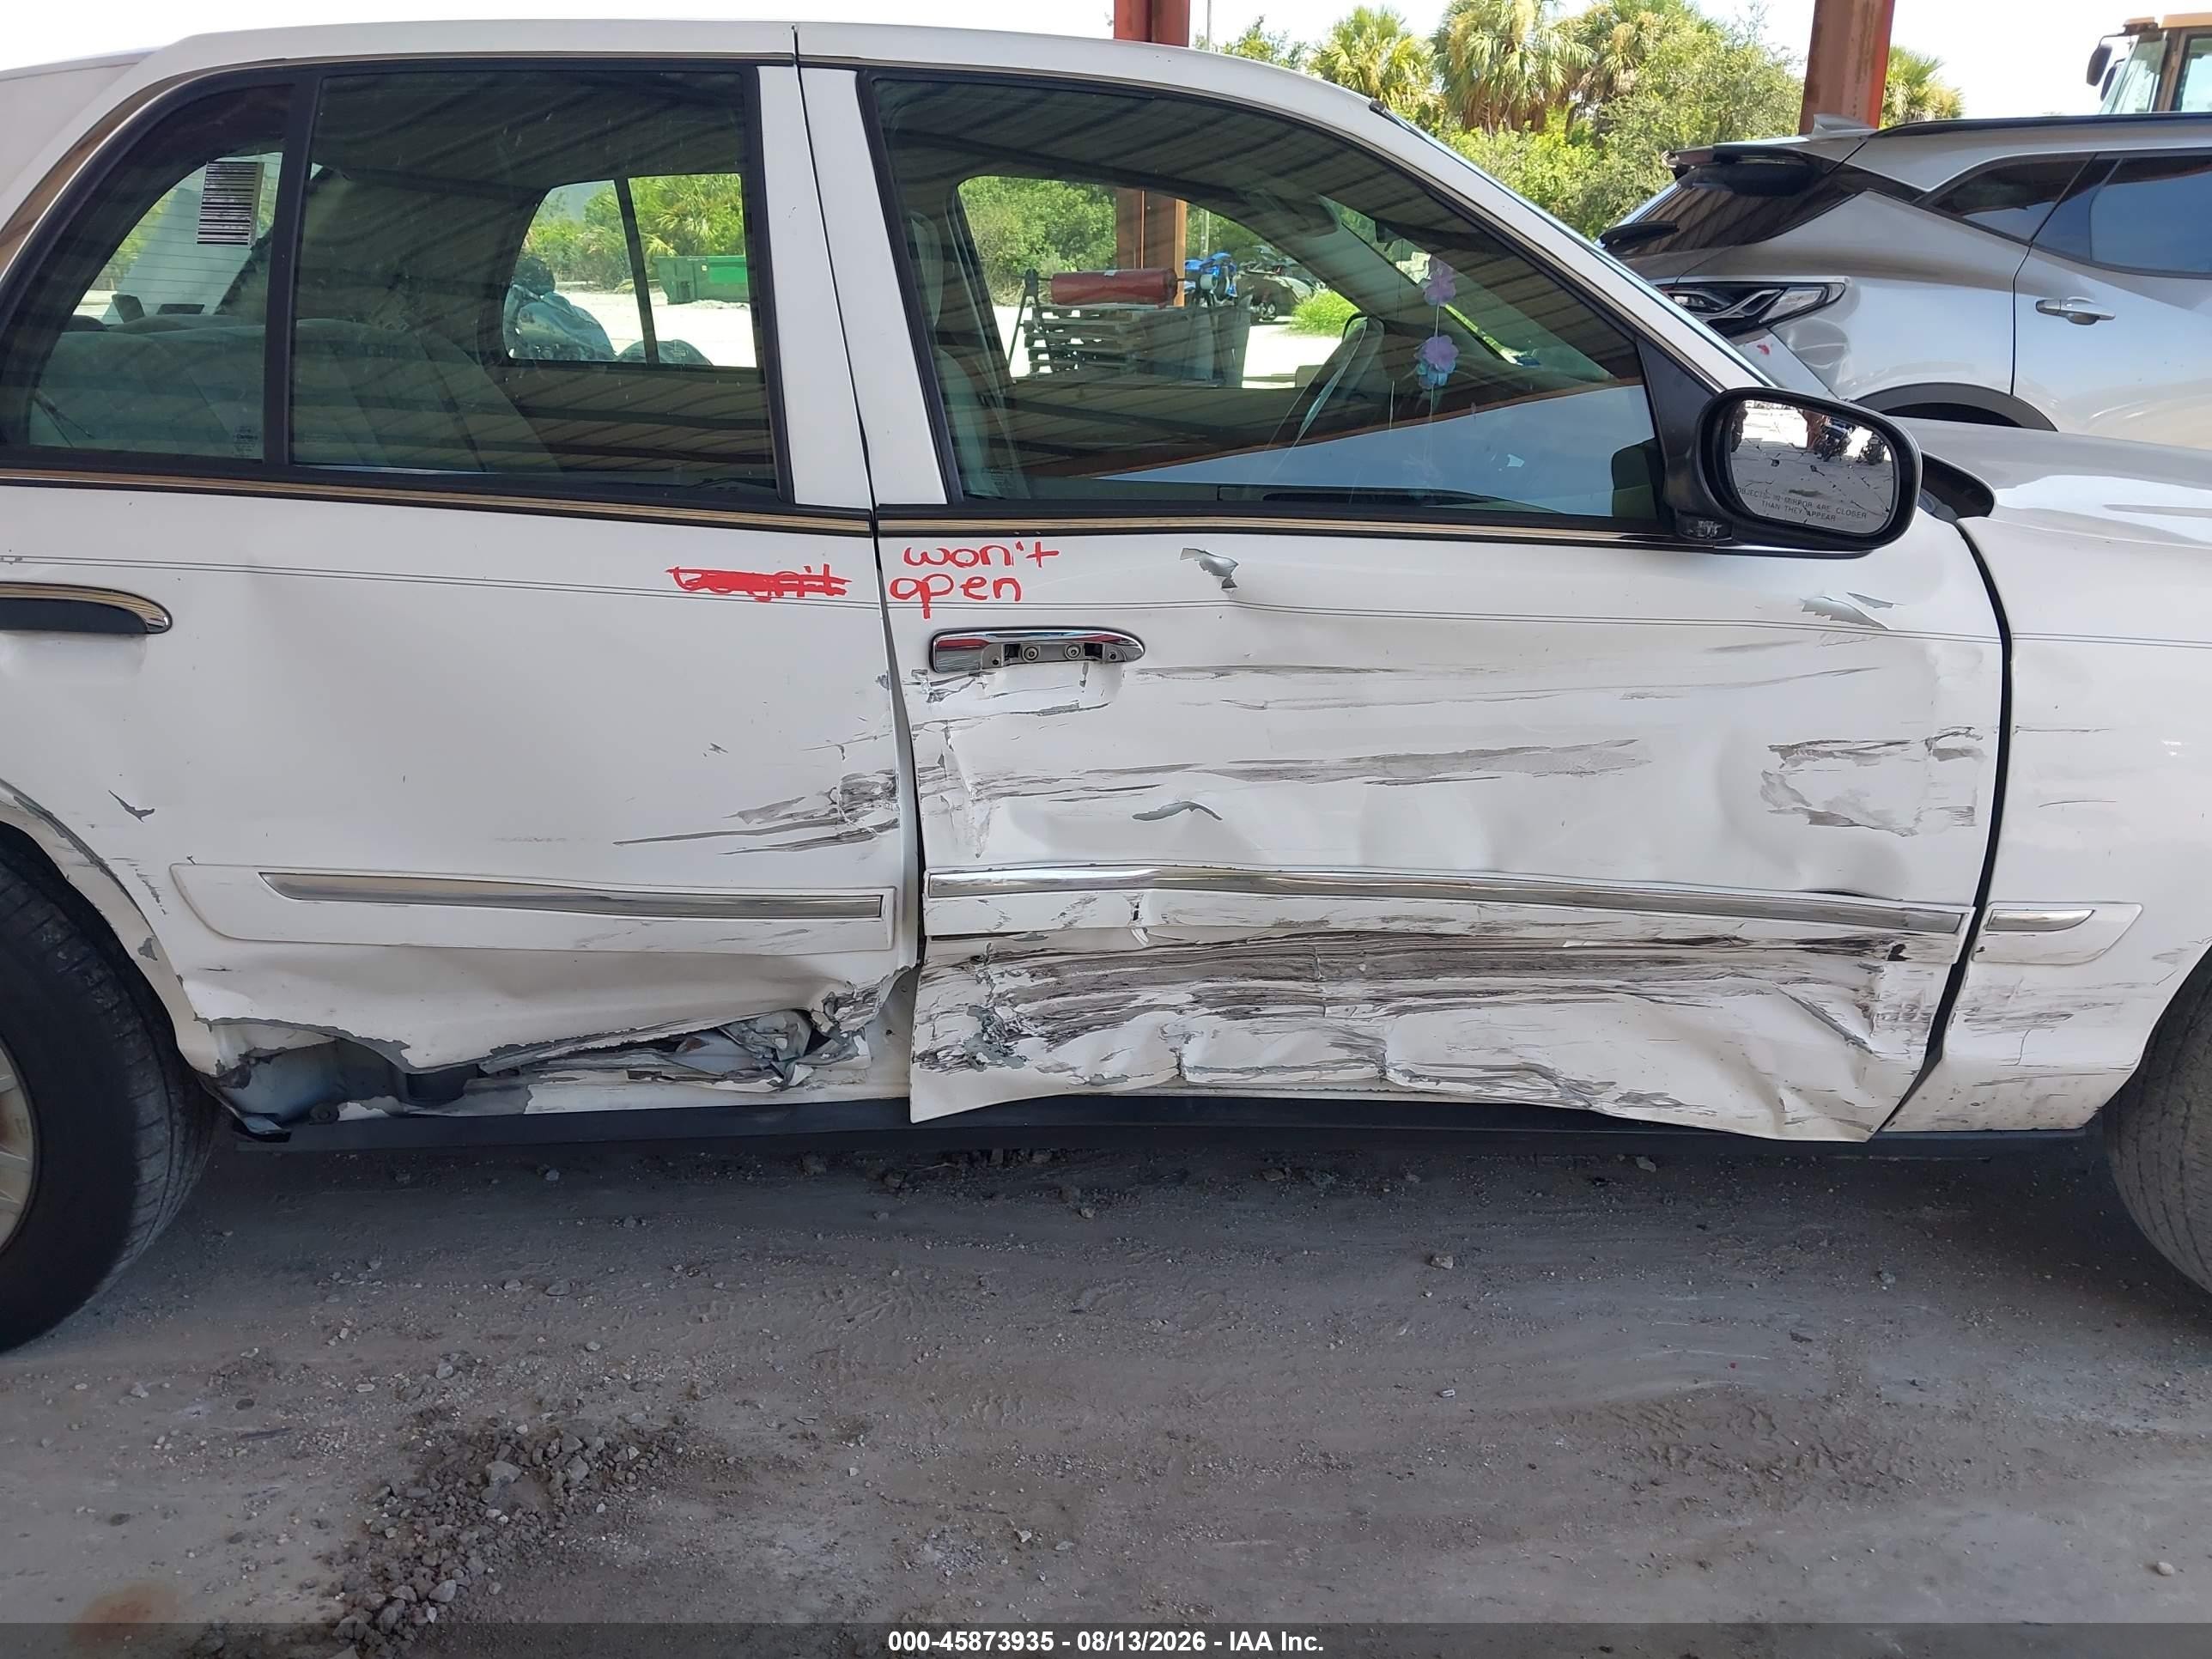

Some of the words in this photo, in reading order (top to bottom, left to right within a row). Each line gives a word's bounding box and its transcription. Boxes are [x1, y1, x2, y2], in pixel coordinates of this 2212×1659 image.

[1737, 487, 1770, 500] OBJECTS
[1784, 497, 1813, 508] MIRROR
[1836, 507, 1868, 520] CLOSER
[1761, 501, 1780, 510] THAN
[1785, 505, 1803, 514] THEY
[1807, 511, 1836, 522] APPEAR
[902, 542, 1059, 568] won't
[889, 573, 1022, 619] open
